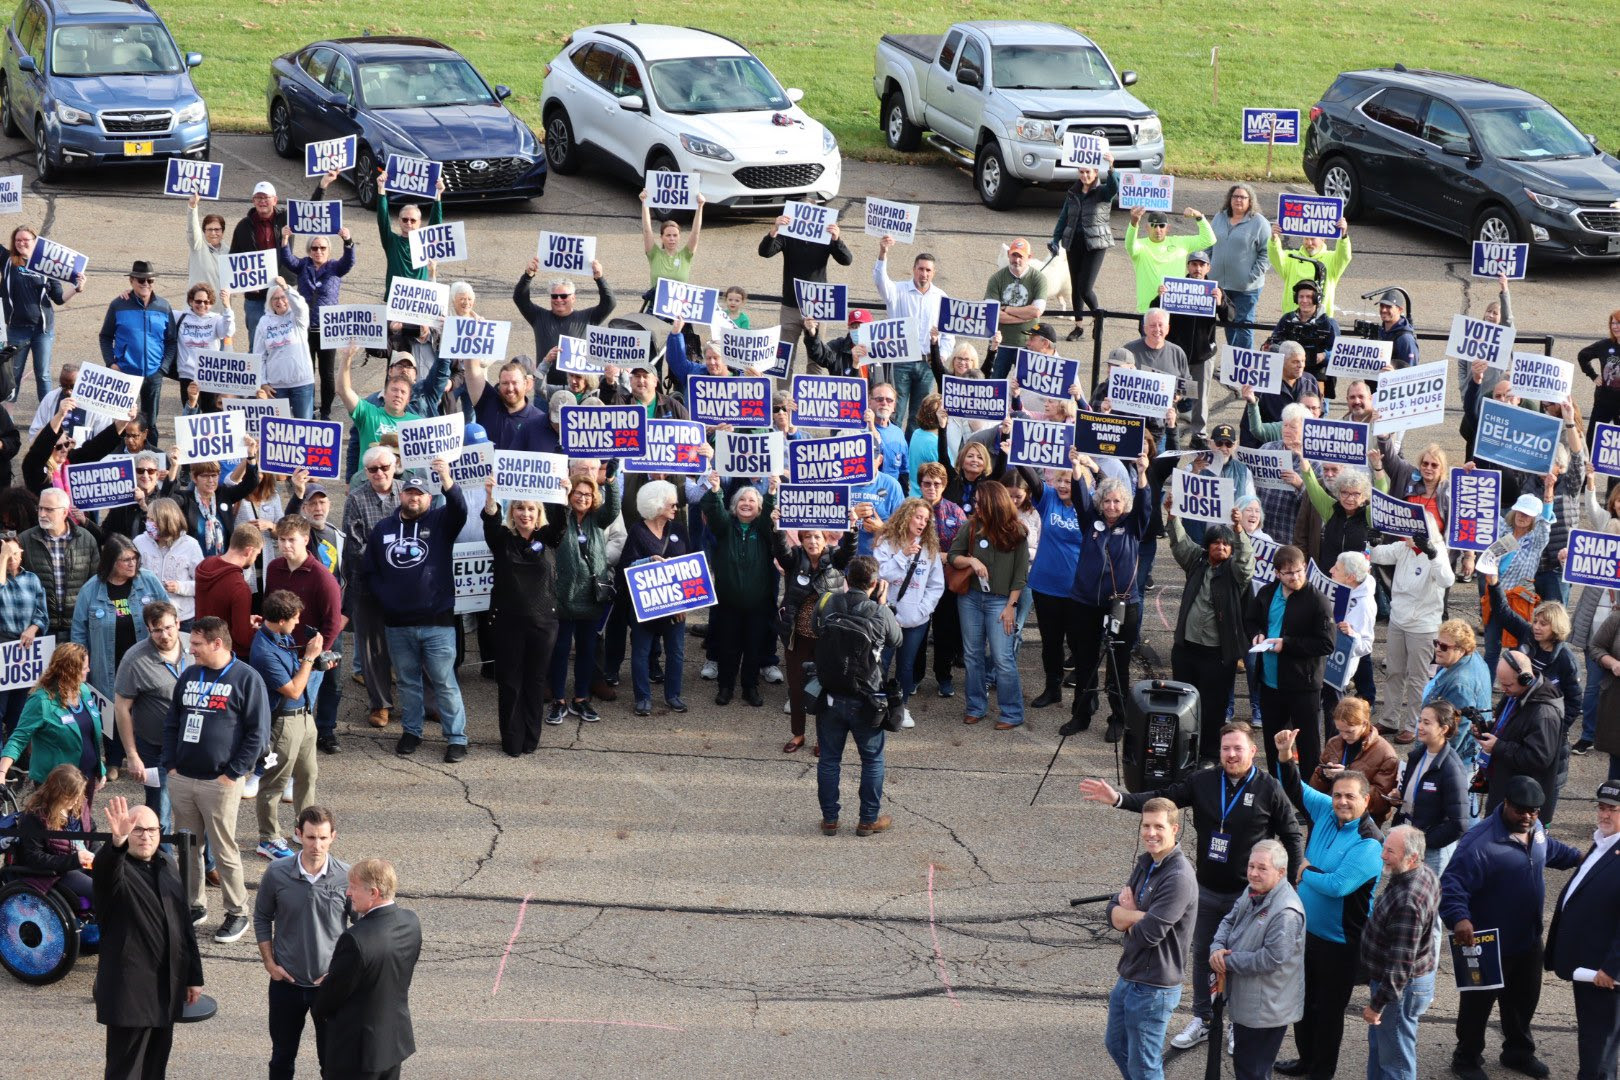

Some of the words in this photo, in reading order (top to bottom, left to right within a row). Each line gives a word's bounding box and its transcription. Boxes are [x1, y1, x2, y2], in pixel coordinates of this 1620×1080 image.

[315, 142, 347, 159] VOTE
[1073, 135, 1101, 151] VOTE
[313, 155, 347, 172] JOSH
[1069, 149, 1101, 165] JOSH
[177, 160, 210, 180] VOTE
[396, 157, 431, 176] VOTE
[172, 177, 210, 195] JOSH
[391, 173, 428, 192] JOSH
[656, 173, 688, 189] VOTE
[653, 189, 688, 205] JOSH
[1122, 186, 1167, 198] SHAPIRO
[295, 202, 331, 218] VOTE
[868, 203, 904, 220] SHAPIRO
[1122, 197, 1169, 209] GOVERNOR
[1284, 202, 1301, 211] PA
[1303, 204, 1337, 220] DAVIS
[795, 203, 828, 223] VOTE
[294, 217, 331, 233] JOSH
[788, 218, 824, 239] JOSH
[867, 215, 912, 233] GOVERNOR
[1282, 217, 1336, 235] SHAPIRO
[419, 225, 453, 244] VOTE
[420, 241, 455, 262] JOSH
[549, 235, 584, 254] VOTE
[1482, 243, 1517, 261] VOTE
[35, 242, 77, 267] VOTE
[229, 253, 265, 272] VOTE
[545, 250, 583, 270] JOSH
[34, 255, 73, 280] JOSH
[1479, 260, 1515, 276] JOSH
[230, 270, 267, 289] JOSH
[1164, 281, 1205, 296] SHAPIRO
[394, 284, 437, 302] SHAPIRO
[668, 281, 704, 304] VOTE
[800, 282, 835, 301] VOTE
[1163, 293, 1213, 306] GOVERNOR
[324, 311, 371, 324] SHAPIRO
[662, 298, 703, 320] JOSH
[949, 300, 987, 318] VOTE
[183, 328, 213, 338] Deliver
[324, 324, 383, 337] GOVERNOR
[456, 320, 496, 336] VOTE
[870, 320, 906, 340] VOTE
[944, 315, 986, 335] JOSH
[1464, 319, 1504, 345] VOTE
[451, 334, 494, 355] JOSH
[590, 332, 634, 347] SHAPIRO
[724, 334, 769, 348] SHAPIRO
[589, 345, 645, 360] GOVERNOR
[724, 345, 775, 359] GOVERNOR
[869, 339, 909, 359] JOSH
[1336, 343, 1379, 359] SHAPIRO
[1456, 337, 1500, 363] JOSH
[199, 355, 246, 372] SHAPIRO
[1027, 352, 1066, 377] VOTE
[1232, 349, 1270, 371] VOTE
[1515, 359, 1560, 377] SHAPIRO
[81, 369, 130, 394] SHAPIRO
[197, 369, 256, 385] GOVERNOR
[1022, 371, 1063, 396] JOSH
[1112, 373, 1160, 392] SHAPIRO
[1229, 368, 1270, 388] JOSH
[1512, 372, 1568, 393] GOVERNOR
[77, 382, 134, 408] GOVERNOR
[695, 380, 764, 399] SHAPIRO
[798, 380, 861, 401] SHAPIRO
[945, 381, 994, 399] SHAPIRO
[1111, 387, 1168, 407] GOVERNOR
[1378, 378, 1444, 403] DELUZIO
[696, 399, 739, 417] DAVIS
[741, 400, 764, 408] FOR
[945, 396, 1005, 411] GOVERNOR
[1410, 392, 1443, 406] HOUSE
[741, 408, 765, 417] PA
[798, 400, 838, 418] DAVIS
[840, 401, 861, 409] FOR
[840, 409, 862, 419] PA
[188, 415, 232, 438] VOTE
[567, 411, 639, 430] SHAPIRO
[1080, 413, 1125, 426] STEELWORKERS
[1091, 422, 1127, 434] SHAPIRO
[1485, 413, 1510, 426] CHRIS
[266, 422, 334, 446] SHAPIRO
[401, 423, 452, 442] SHAPIRO
[568, 430, 613, 448] DAVIS
[1022, 422, 1066, 445] VOTE
[1097, 432, 1121, 442] DAVIS
[1305, 424, 1354, 441] SHAPIRO
[1482, 423, 1552, 454] DELUZIO
[188, 434, 234, 458] JOSH
[404, 435, 461, 456] GOVERNOR
[615, 438, 639, 447] PA
[728, 435, 769, 453] VOTE
[796, 438, 867, 463] SHAPIRO
[1305, 438, 1364, 455] GOVERNOR
[266, 444, 305, 465] DAVIS
[307, 447, 332, 455] FOR
[307, 456, 332, 466] PA
[1017, 443, 1065, 465] JOSH
[1515, 445, 1548, 460] CONGRESS
[498, 457, 551, 474] SHAPIRO
[725, 454, 771, 472] JOSH
[798, 460, 842, 480] DAVIS
[843, 457, 866, 465] FOR
[843, 464, 867, 475] PA
[70, 467, 120, 486] SHAPIRO
[497, 472, 562, 490] GOVERNOR
[72, 480, 134, 500] GOVERNOR
[1182, 474, 1220, 498] VOTE
[781, 490, 833, 504] SHAPIRO
[1461, 475, 1477, 519] DAVIS
[780, 505, 846, 518] GOVERNOR
[1180, 495, 1221, 518] JOSH
[1372, 497, 1412, 519] SHAPIRO
[1476, 477, 1496, 545] SHAPIRO
[1372, 510, 1426, 531] GOVERNOR
[1459, 519, 1469, 542] PA
[634, 559, 702, 591] SHAPIRO
[1572, 556, 1617, 577] DAVIS
[638, 582, 684, 607] DAVIS
[682, 578, 705, 589] FOR
[684, 586, 708, 599] PA
[3, 640, 42, 664] VOTE
[184, 680, 232, 696] SHAPIRO
[209, 701, 226, 710] PA
[187, 717, 200, 729] ALL
[1210, 843, 1227, 853] STAFF
[1212, 836, 1228, 846] EVENT
[1481, 935, 1495, 943] FOR
